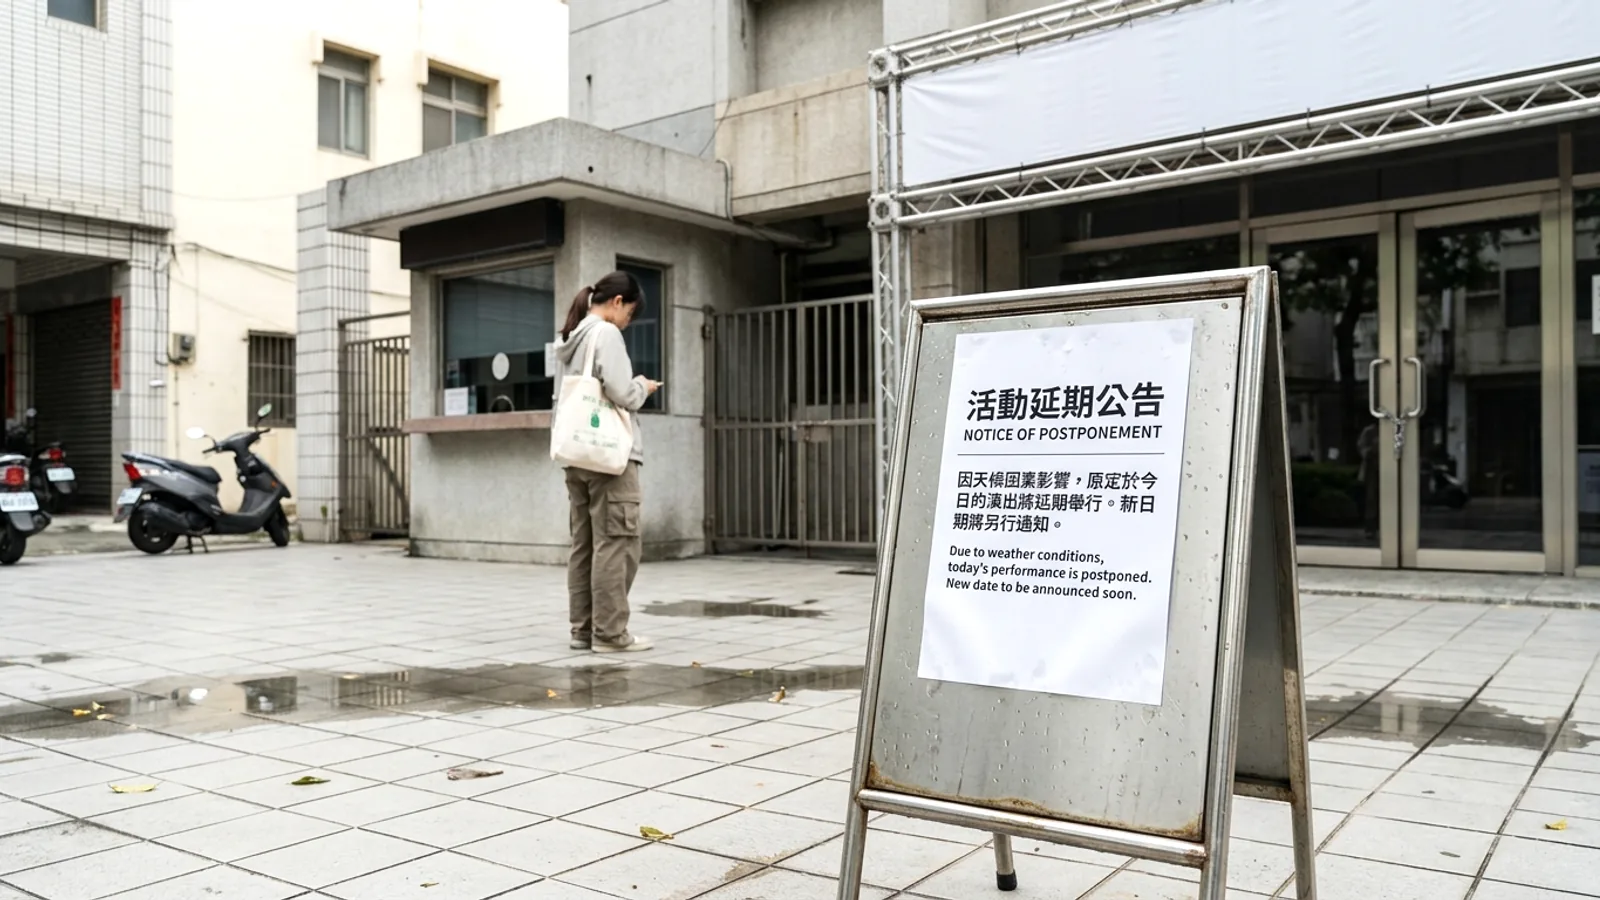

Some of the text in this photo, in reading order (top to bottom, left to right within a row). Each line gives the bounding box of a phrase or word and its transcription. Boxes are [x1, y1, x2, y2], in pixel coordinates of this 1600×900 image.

[967, 381, 1165, 421] 活動延期公告
[964, 425, 1163, 442] NOTICE OF POSTPONEMENT
[949, 545, 1104, 566] Due to weather conditions,
[947, 560, 1152, 584] today's performance is postponed.
[945, 577, 1137, 601] New date to be announced soon.
